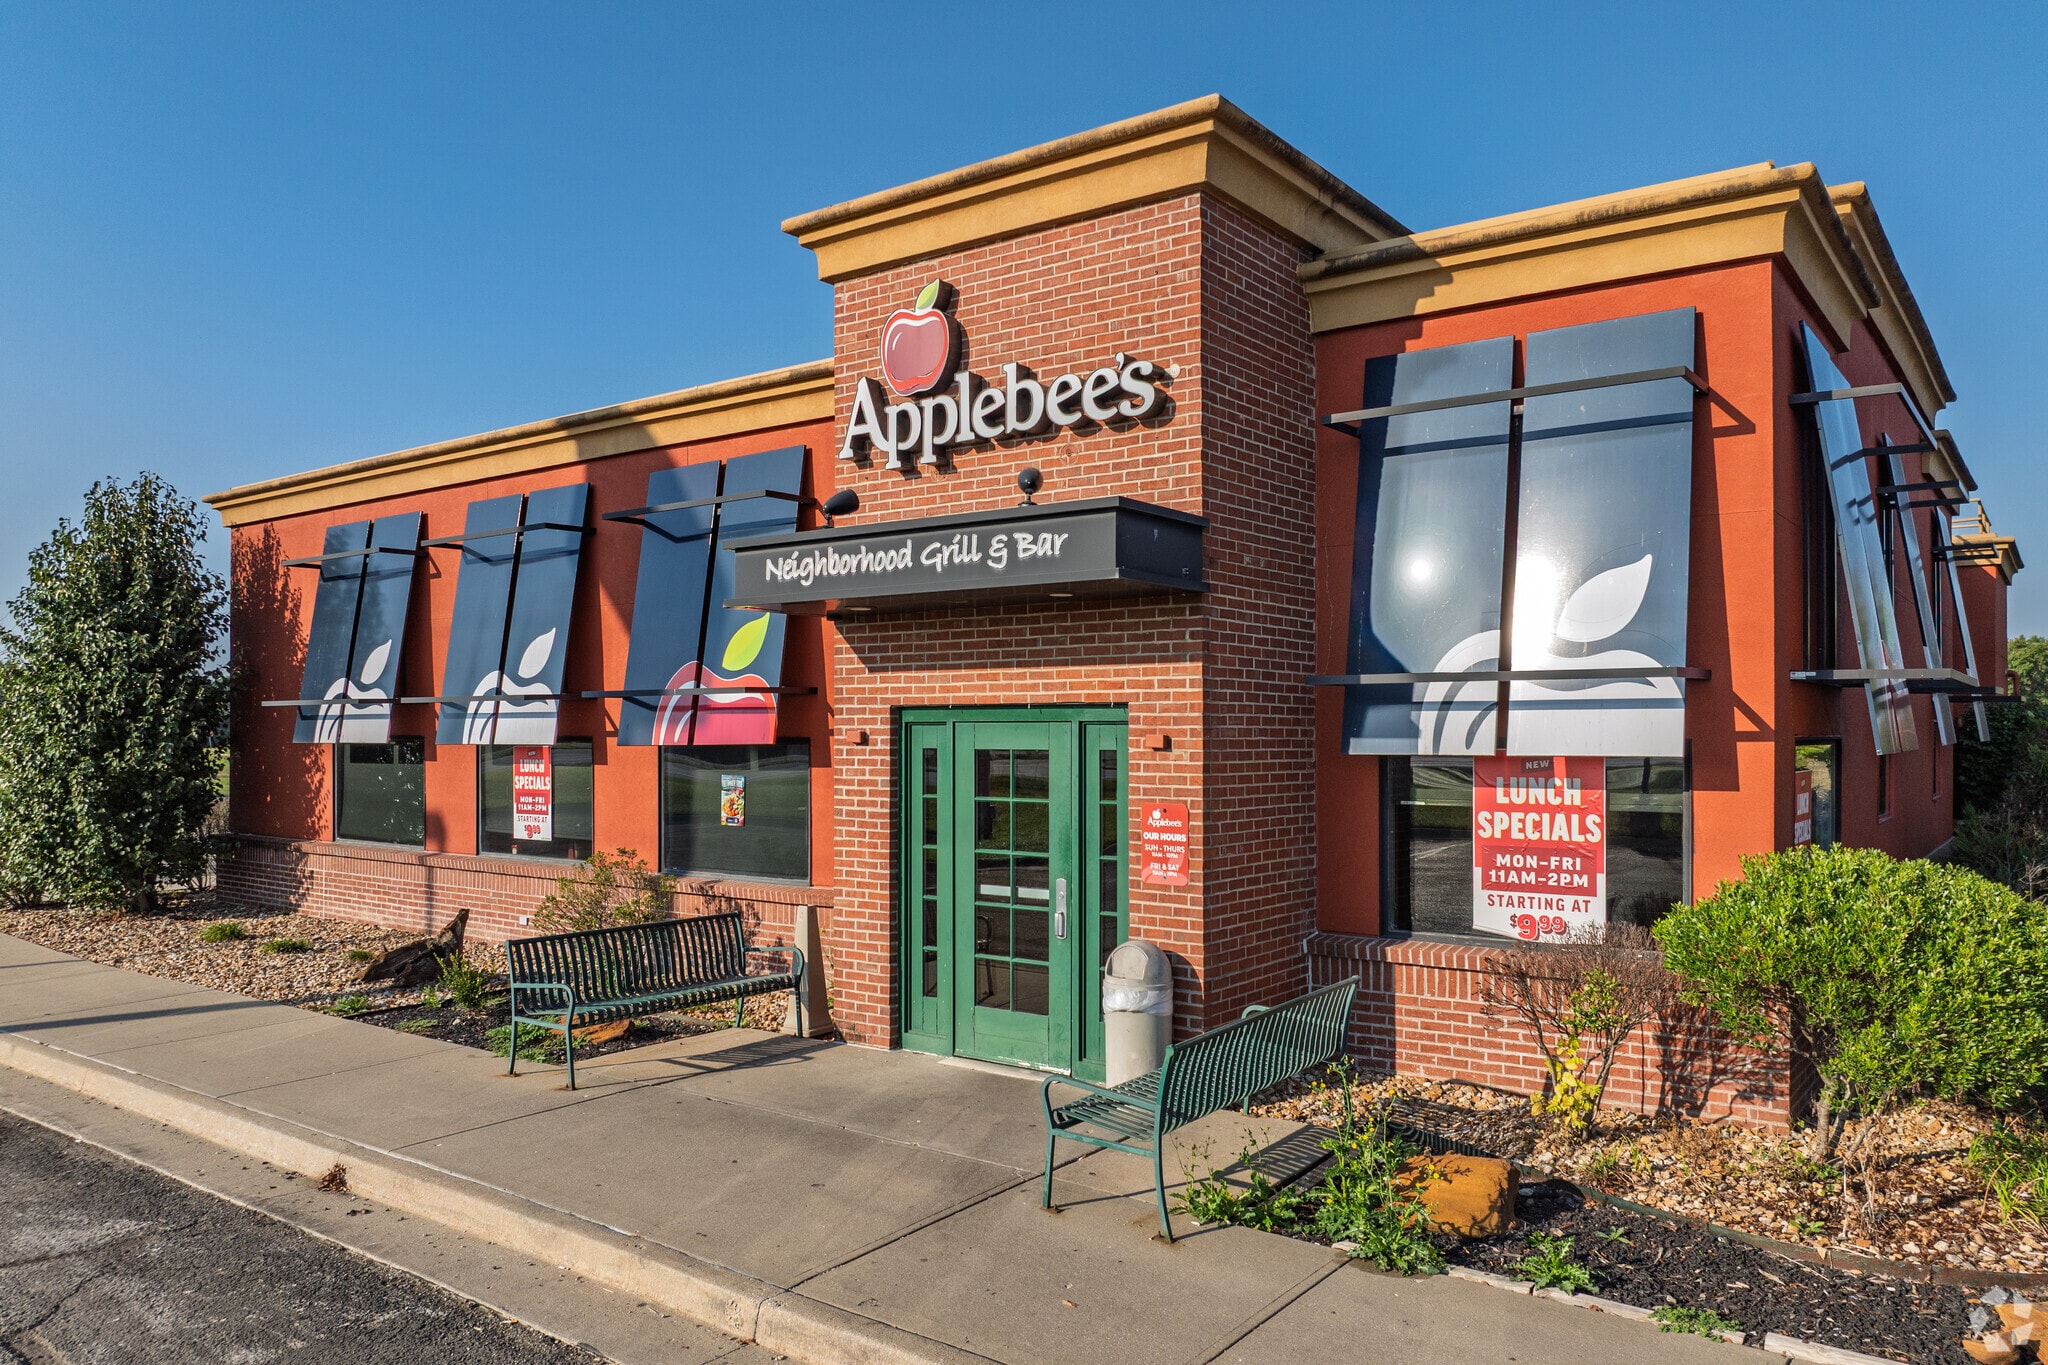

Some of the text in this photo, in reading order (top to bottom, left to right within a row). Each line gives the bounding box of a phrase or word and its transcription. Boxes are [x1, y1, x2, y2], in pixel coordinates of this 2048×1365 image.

[838, 352, 1156, 470] Applebee's
[765, 532, 1069, 586] Neighborhood Grill & Bar
[520, 759, 544, 773] LUNCH
[1525, 760, 1550, 770] NEW
[515, 775, 550, 790] SPECIALS
[1496, 776, 1582, 806] LUNCH
[518, 803, 547, 812] 11AM-2PM
[520, 796, 545, 804] MON-FRI
[1477, 810, 1602, 843] SPECIALS
[1143, 831, 1187, 842] OUR HOURS
[1144, 843, 1159, 851] SUN
[1163, 845, 1185, 853] THURS
[1150, 862, 1160, 870] FRI
[1496, 853, 1581, 871] MON-FRI
[1488, 869, 1588, 888] 11AM-2PM
[1487, 893, 1591, 913] STARTING AT
